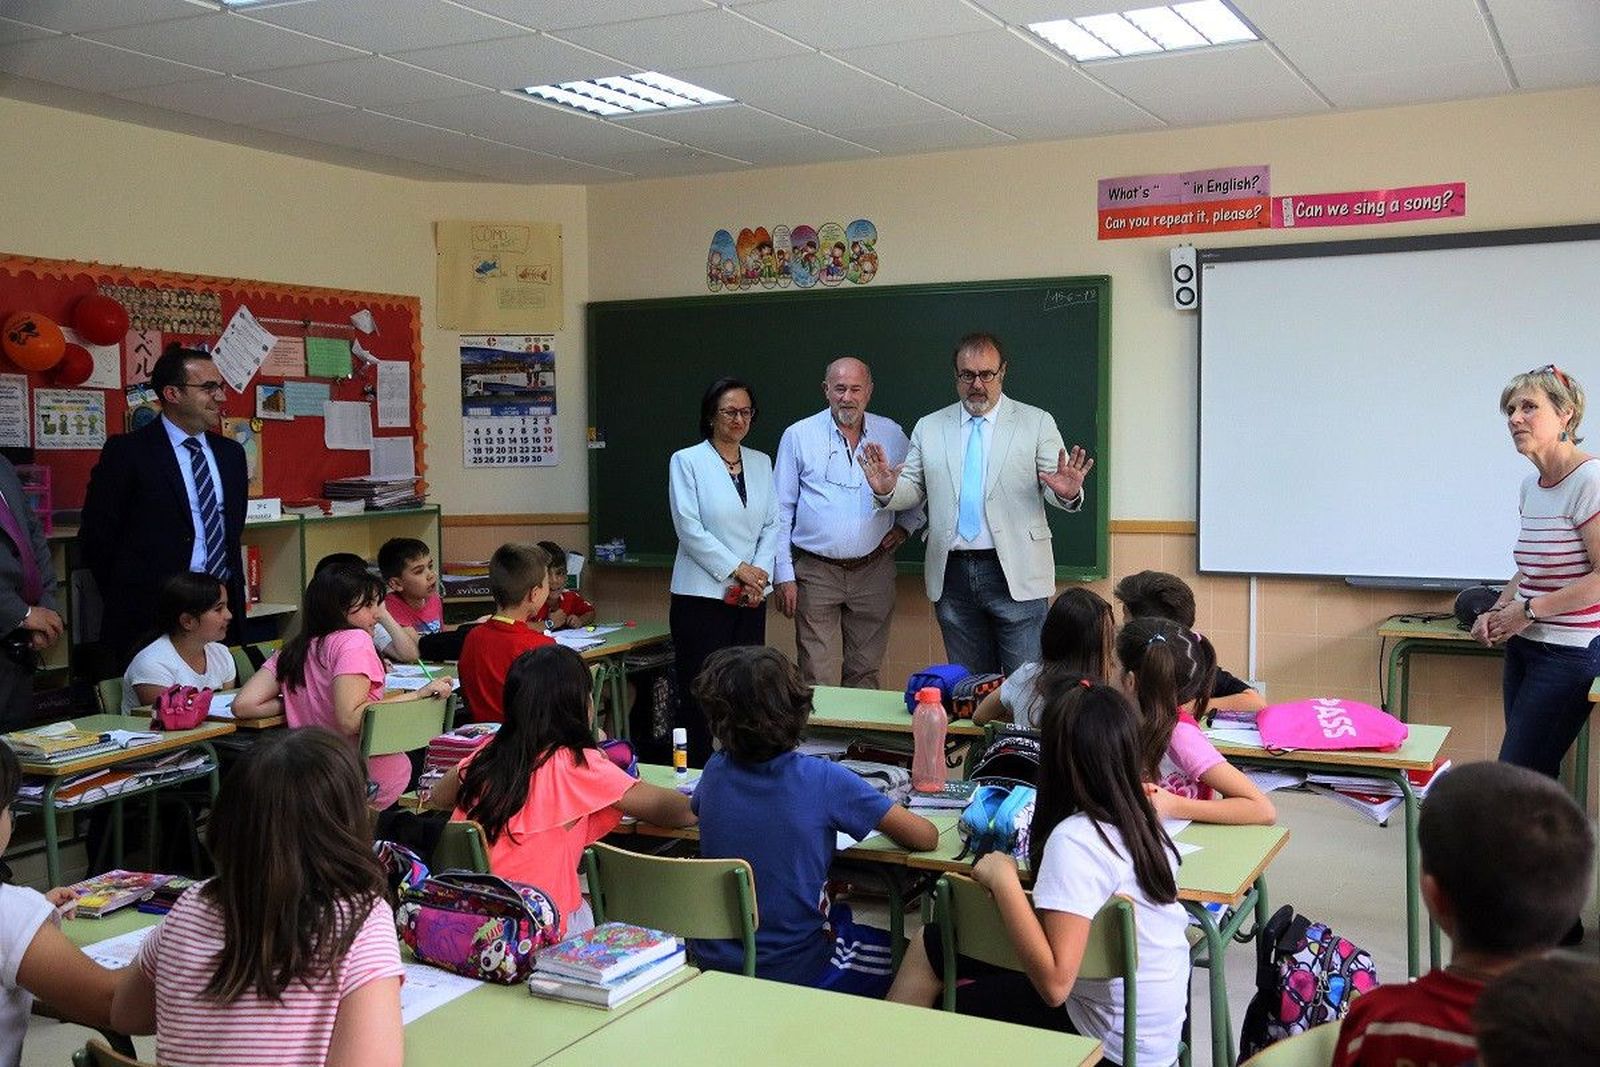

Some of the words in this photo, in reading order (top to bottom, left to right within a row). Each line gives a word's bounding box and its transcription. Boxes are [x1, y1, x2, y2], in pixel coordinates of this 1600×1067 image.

[1108, 185, 1150, 200] What's
[1193, 180, 1203, 194] in
[1207, 175, 1260, 194] English?
[1295, 201, 1323, 218] Can
[1327, 203, 1349, 216] we
[1353, 199, 1385, 217] sing
[1390, 201, 1400, 212] a
[1404, 190, 1453, 212] song?
[1105, 216, 1126, 230] Can
[1129, 216, 1150, 231] you
[1153, 211, 1194, 229] repeat
[1196, 210, 1210, 224] it,
[1212, 204, 1263, 224] please?
[545, 417, 550, 425] 3
